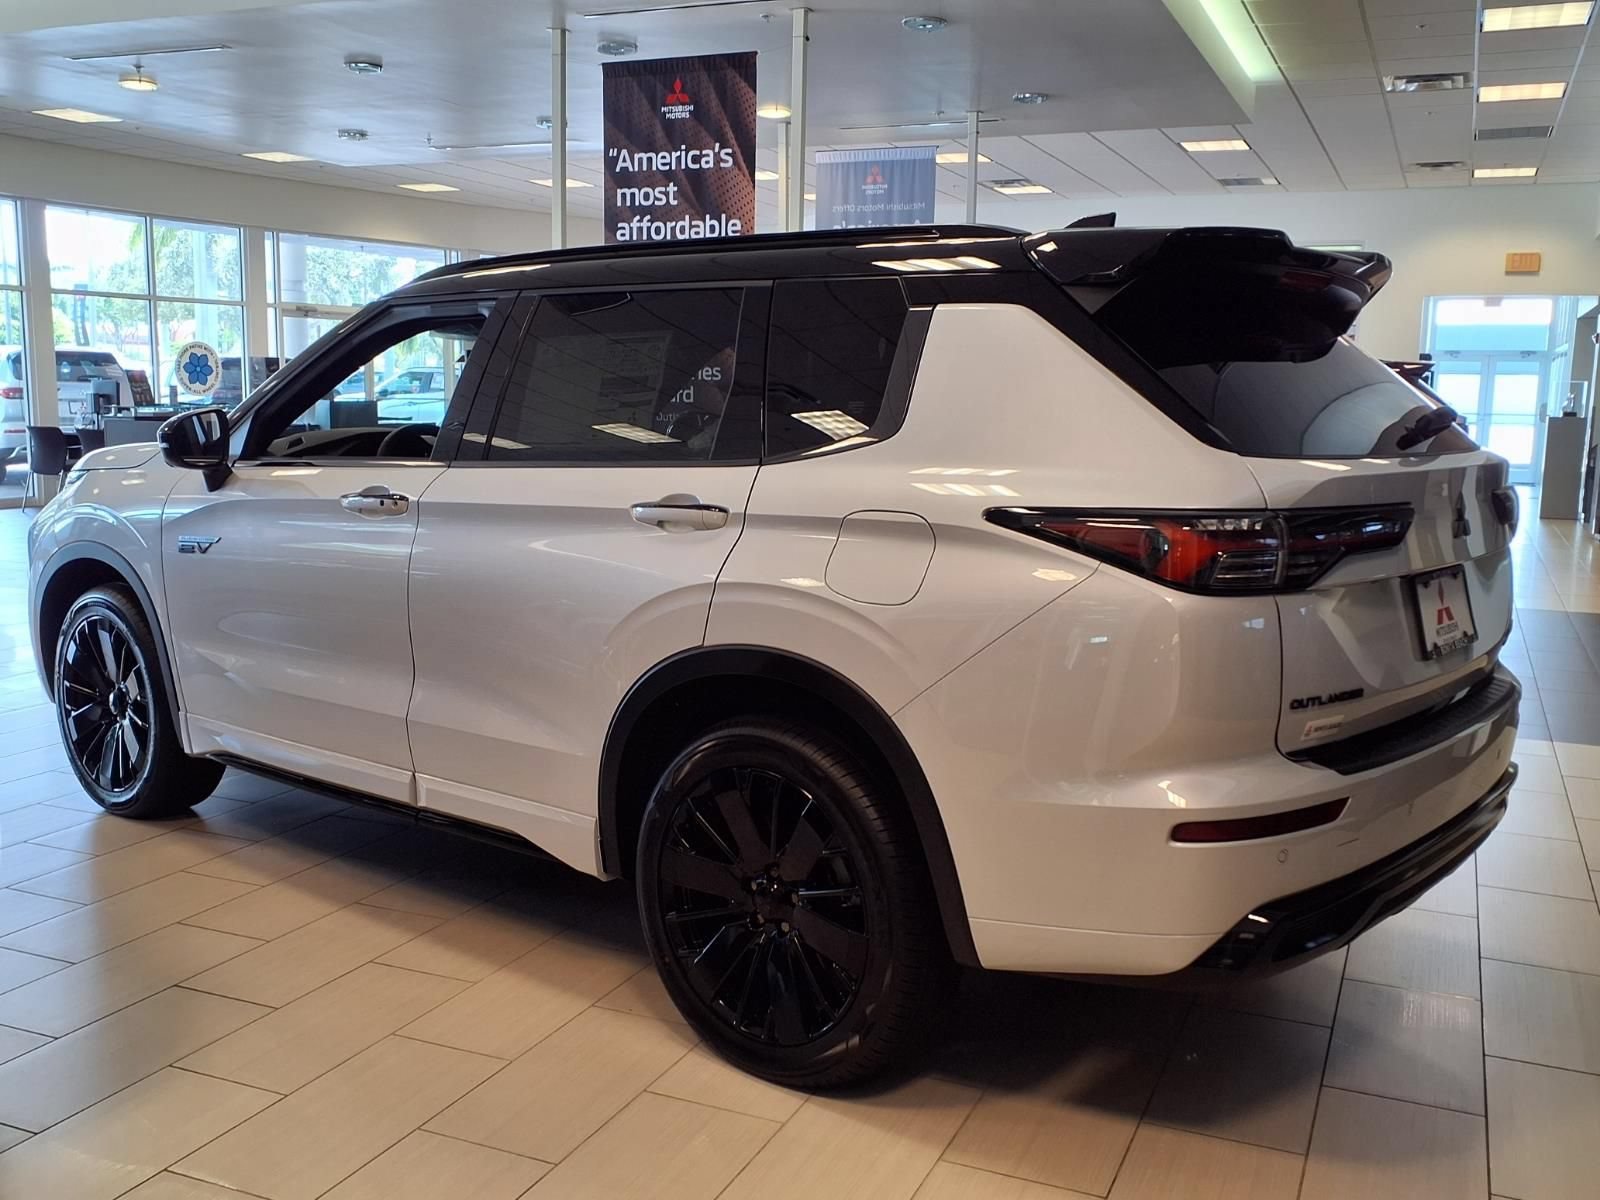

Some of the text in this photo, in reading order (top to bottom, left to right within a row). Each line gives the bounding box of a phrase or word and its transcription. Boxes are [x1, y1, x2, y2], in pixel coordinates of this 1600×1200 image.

[661, 104, 694, 113] MITSUBISHI
[665, 112, 690, 120] MOTORS
[608, 142, 733, 172] "America's
[616, 182, 678, 207] most
[616, 213, 742, 241] affordable
[1290, 687, 1364, 710] OUTLANDER
